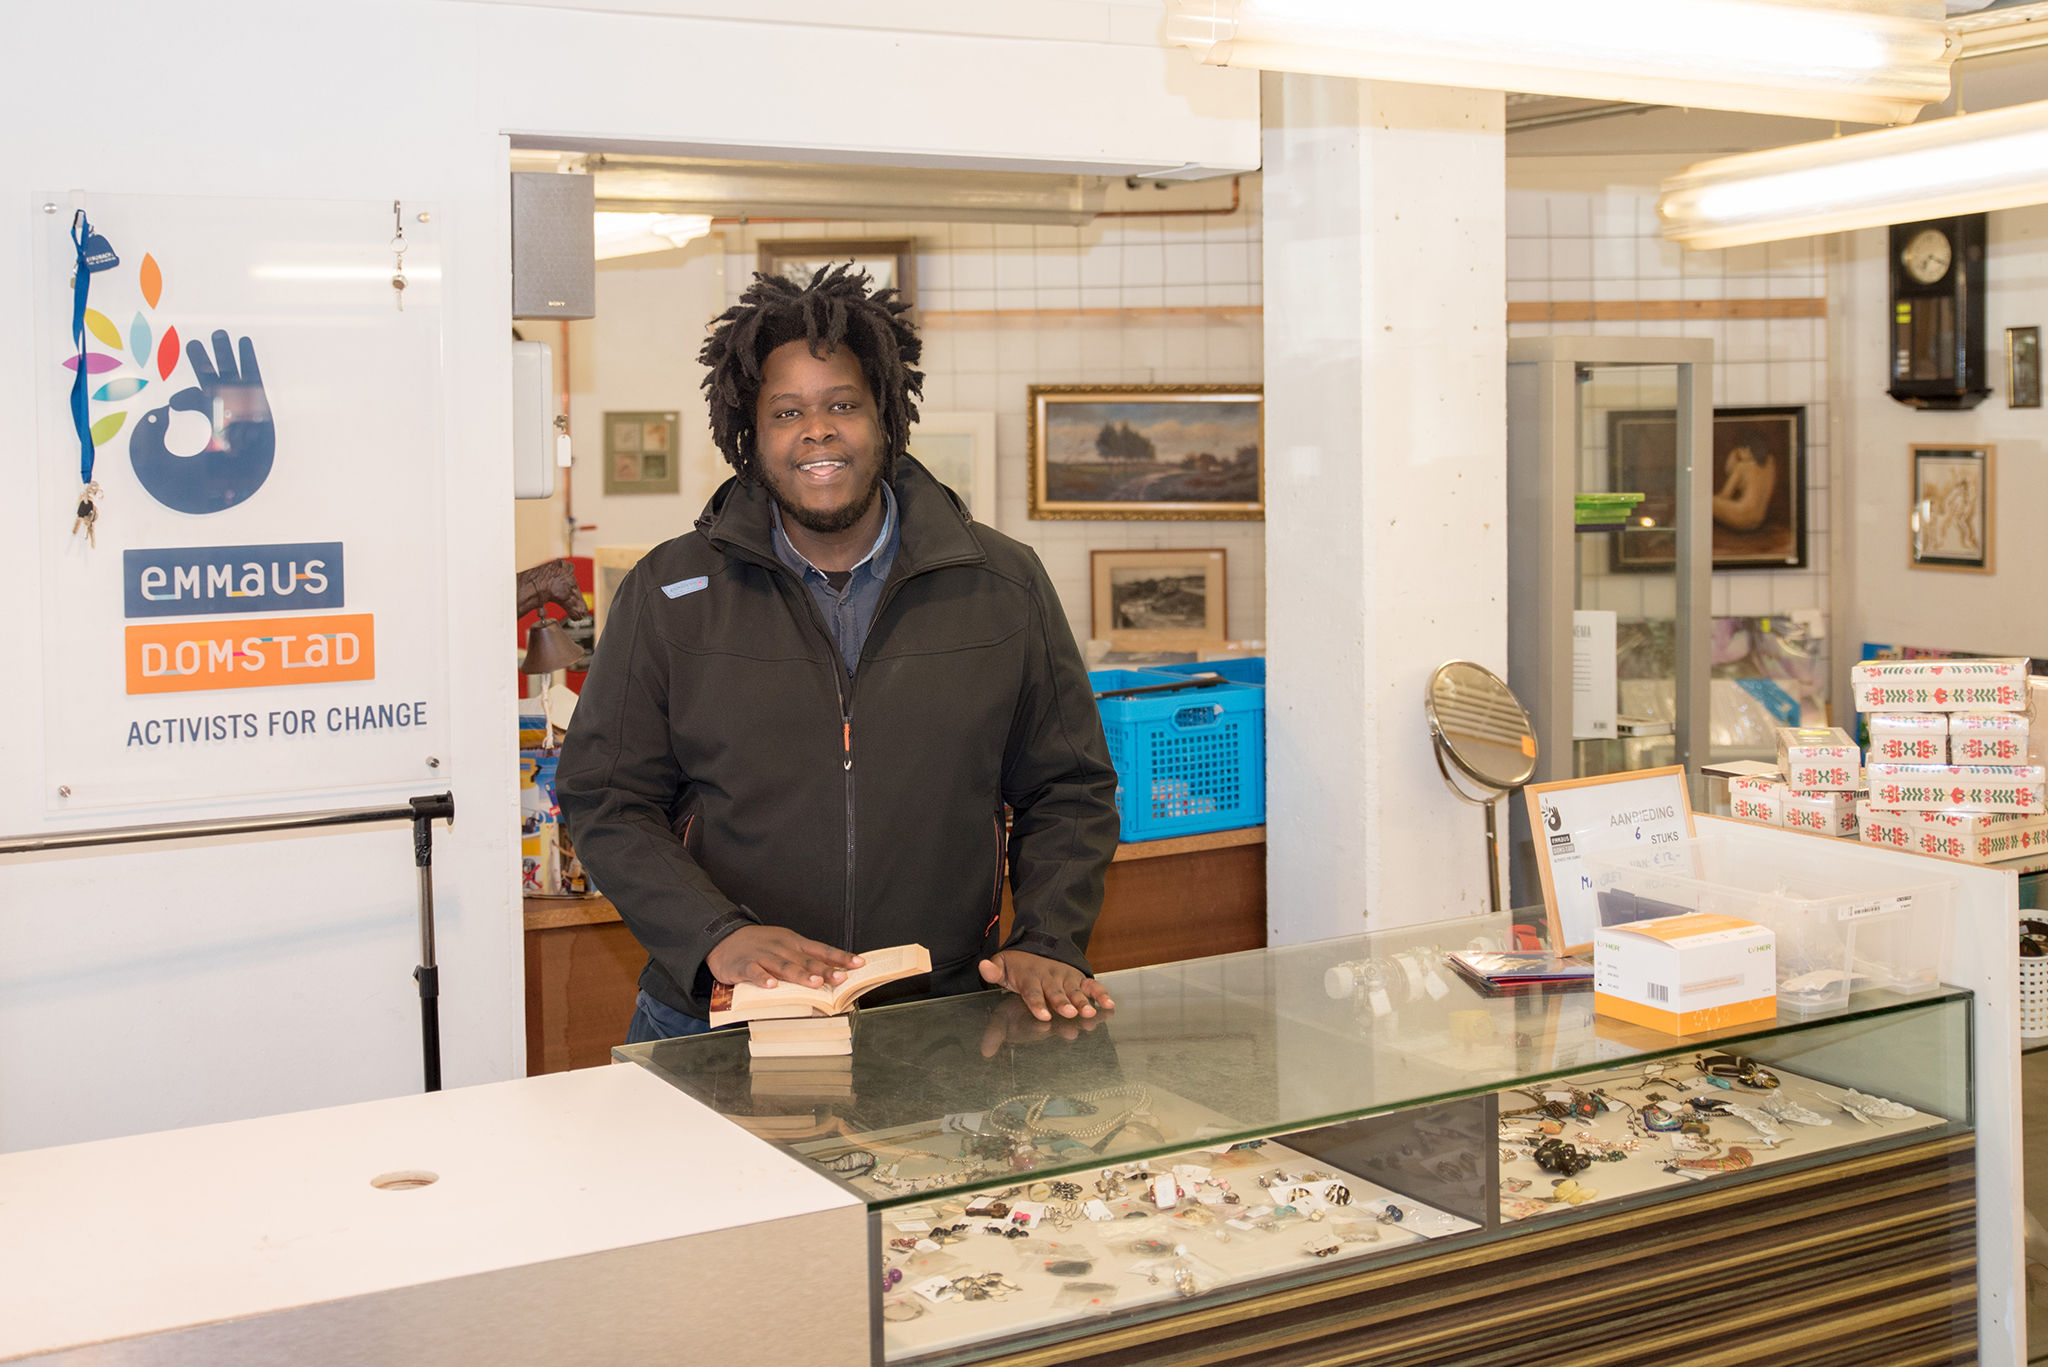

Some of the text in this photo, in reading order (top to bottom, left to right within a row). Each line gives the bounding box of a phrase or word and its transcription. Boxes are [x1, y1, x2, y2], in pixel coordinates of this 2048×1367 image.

[127, 701, 427, 747] ACTIVISTS FOR CHANGE
[1610, 805, 1675, 828] AANBIEDING
[1635, 826, 1679, 845] 6 STUKS
